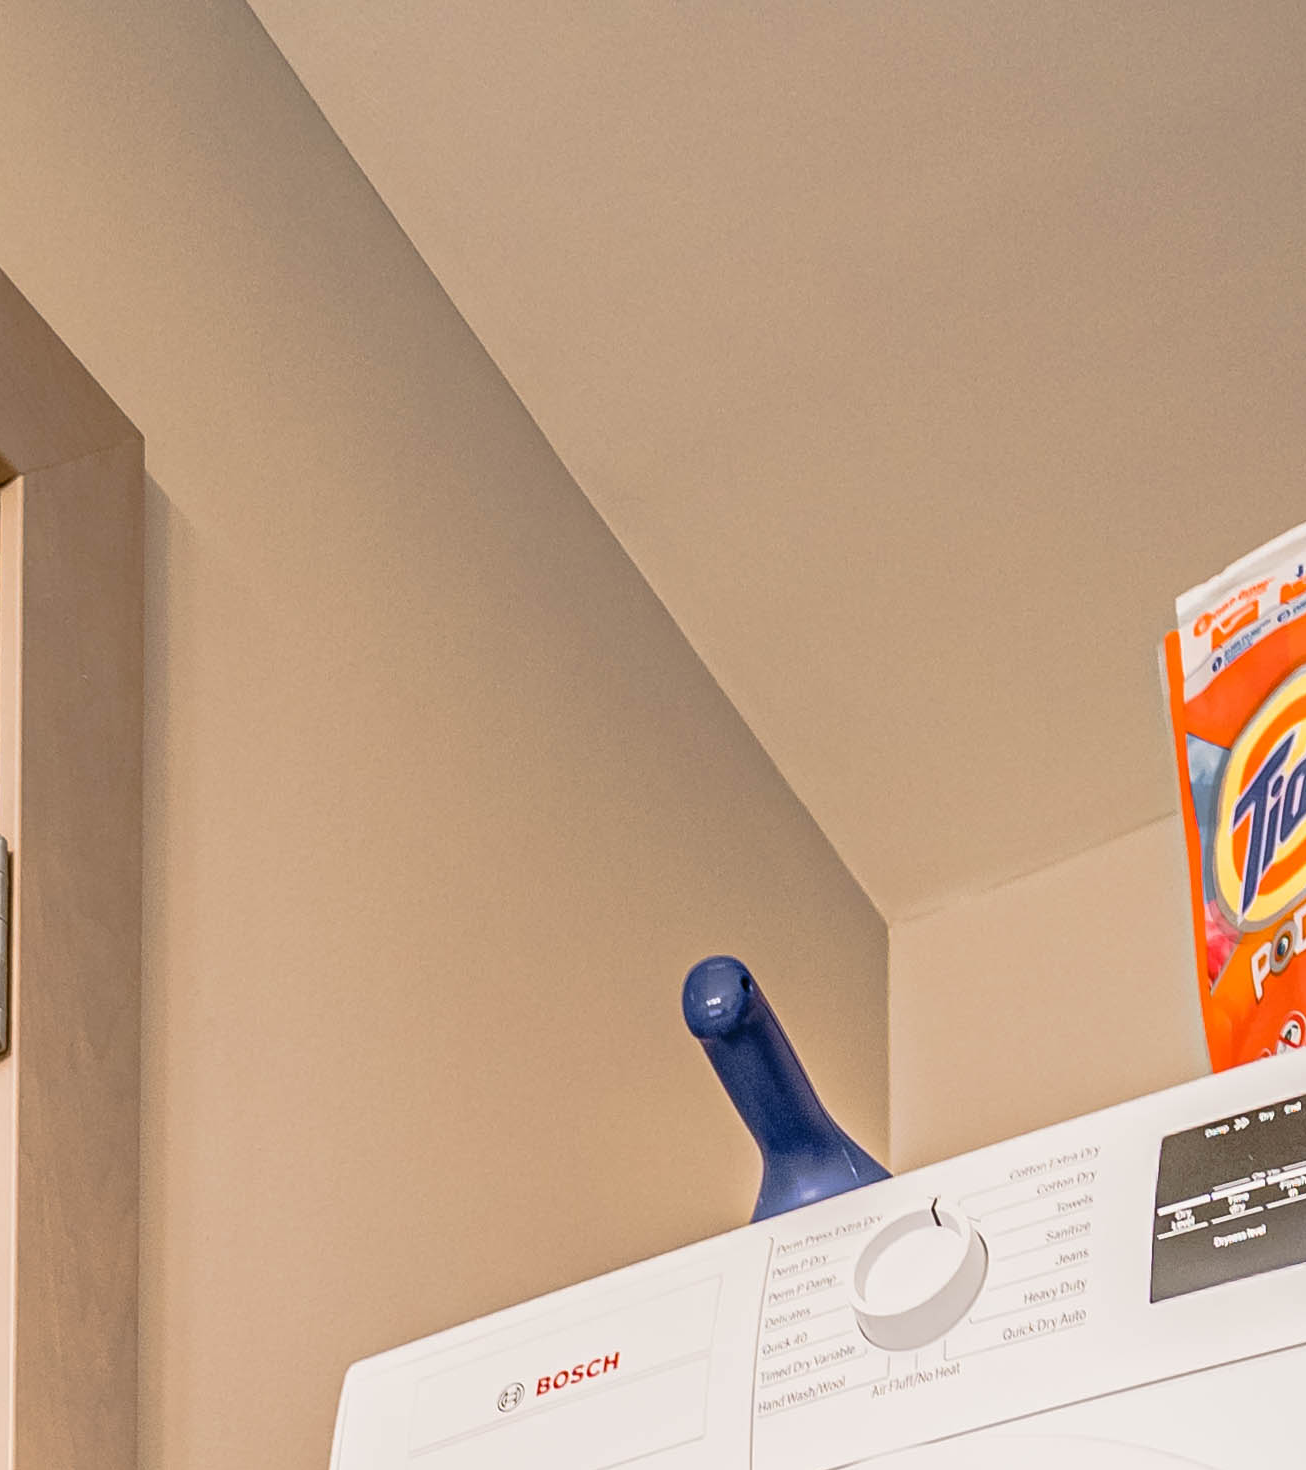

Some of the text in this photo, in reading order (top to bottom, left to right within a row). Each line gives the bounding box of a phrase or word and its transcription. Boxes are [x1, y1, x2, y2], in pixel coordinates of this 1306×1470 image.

[1009, 1163, 1046, 1180] Cotton
[1080, 1145, 1101, 1160] Dry
[1037, 1170, 1097, 1194] Cotton Dry
[1046, 1221, 1091, 1242] Sanitize
[1055, 1248, 1089, 1266] Jeans
[1024, 1279, 1087, 1304] Heavy Duty
[1003, 1309, 1087, 1341] Quick Dry Auto
[536, 1351, 620, 1396] BOSCH
[760, 1345, 856, 1384] Timed Dry Variable
[871, 1384, 886, 1398] Air
[935, 1362, 961, 1379] Heat
[758, 1375, 846, 1413] Hand Wash/Wool
